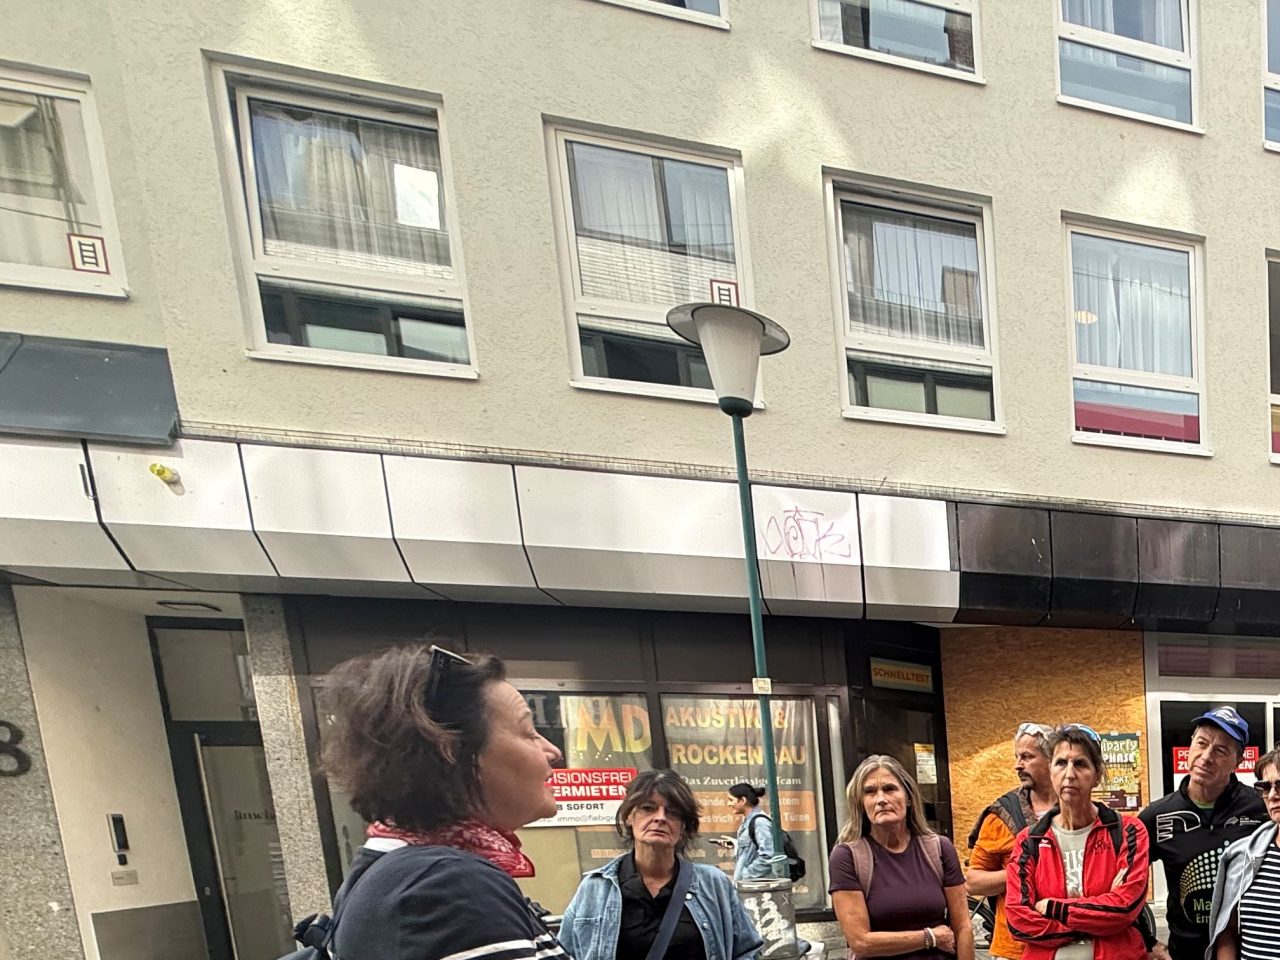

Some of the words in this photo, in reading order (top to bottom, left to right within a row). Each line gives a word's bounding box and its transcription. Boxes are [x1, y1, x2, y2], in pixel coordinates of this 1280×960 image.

[872, 667, 929, 684] SCHNELLTEST
[576, 703, 652, 753] MD
[671, 743, 806, 765] ROCKENAU
[547, 771, 632, 784] ISIONSFREI
[566, 803, 605, 811] SOFORT
